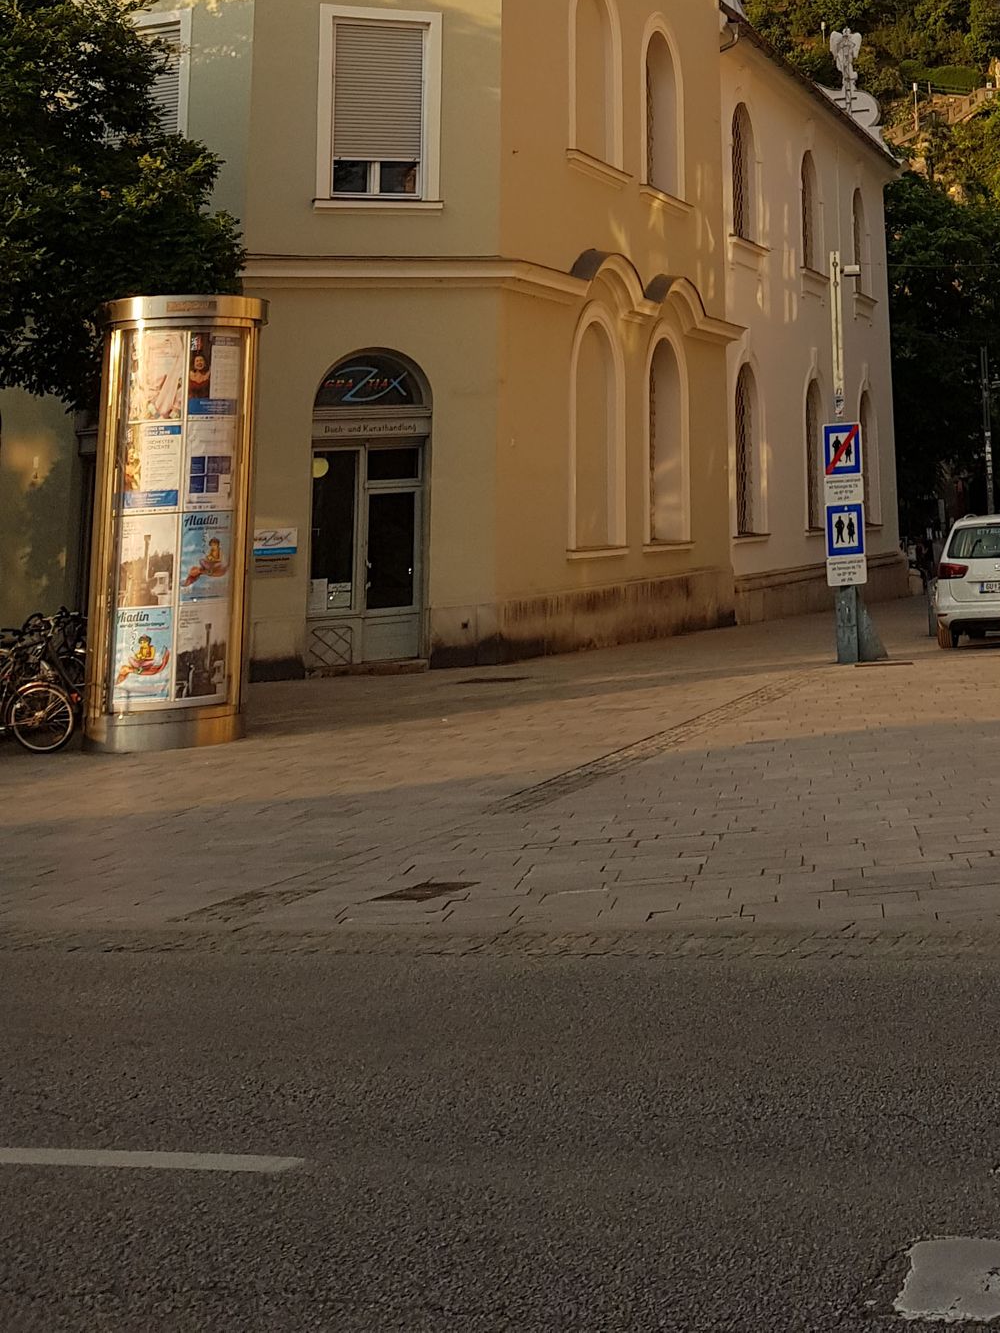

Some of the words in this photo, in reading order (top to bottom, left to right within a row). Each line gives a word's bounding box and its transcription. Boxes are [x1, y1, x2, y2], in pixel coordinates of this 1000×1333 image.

[348, 425, 361, 433] und
[362, 424, 417, 433] Kunsthandlung
[184, 514, 218, 527] Aladin
